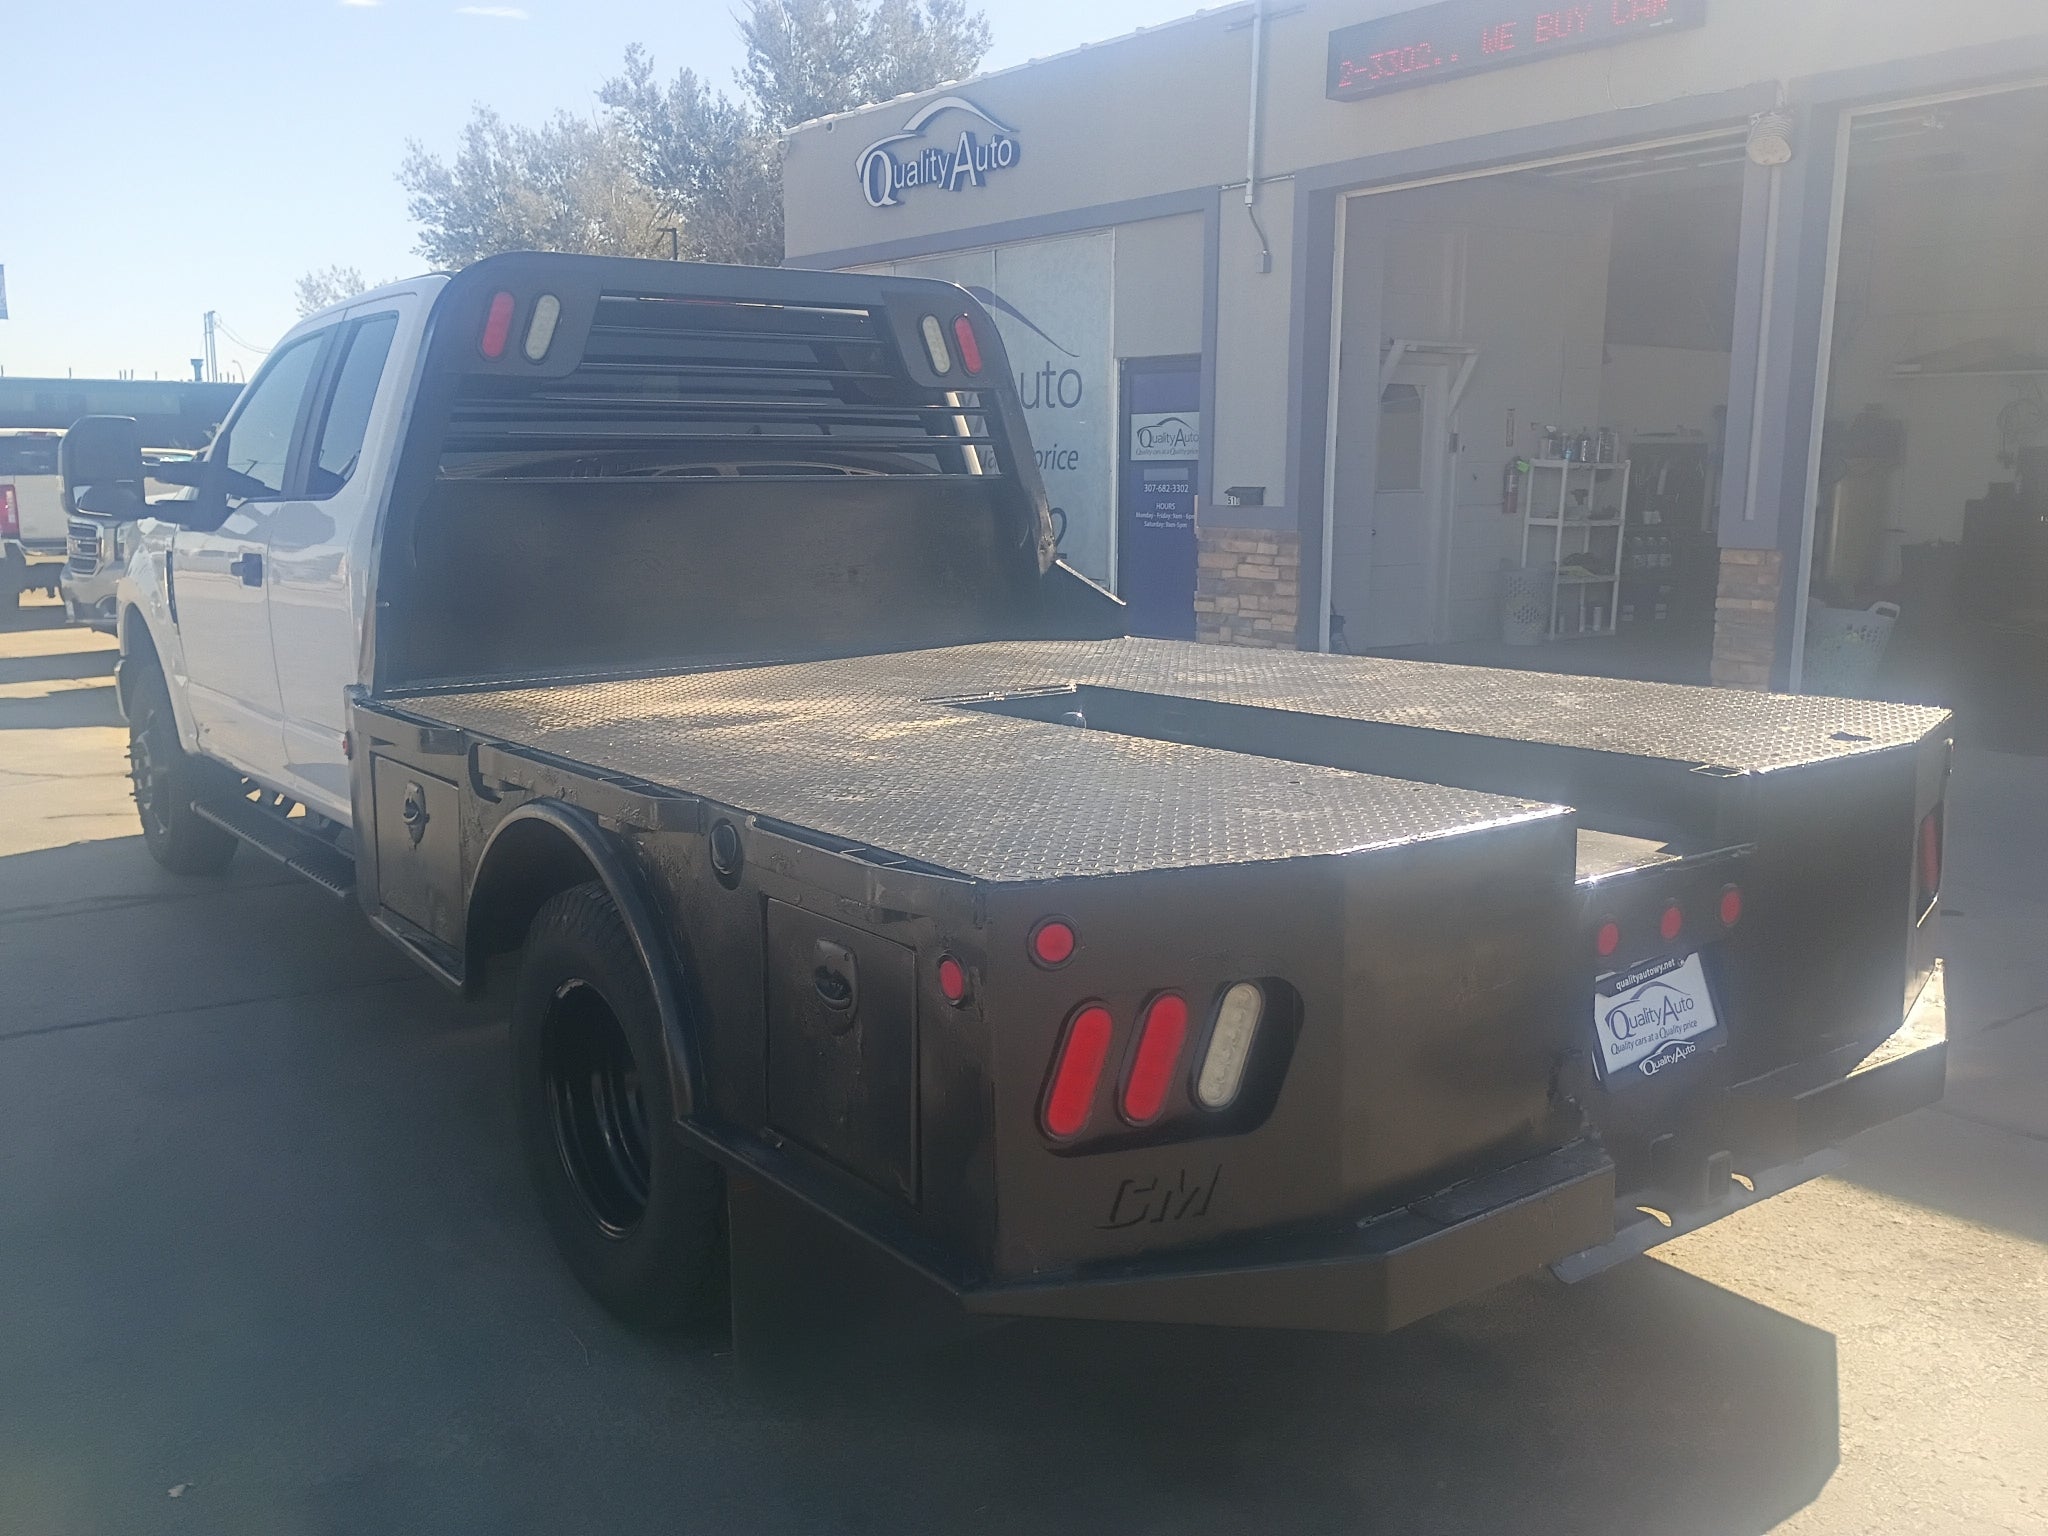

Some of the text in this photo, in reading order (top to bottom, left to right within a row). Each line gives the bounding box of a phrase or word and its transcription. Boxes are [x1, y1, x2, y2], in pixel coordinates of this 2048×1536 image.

[1482, 22, 1517, 54] WE
[1535, 2, 1592, 43] BUY
[1020, 361, 1083, 409] uto
[1143, 483, 1189, 493] 307-682-3302
[1156, 502, 1176, 510] HOURS
[1615, 958, 1676, 991] qualityautowy.net
[1610, 1039, 1635, 1056] Quality
[1634, 1036, 1648, 1047] cars
[1647, 1033, 1655, 1043] at
[1658, 1024, 1682, 1039] Quality
[1682, 1019, 1698, 1033] price
